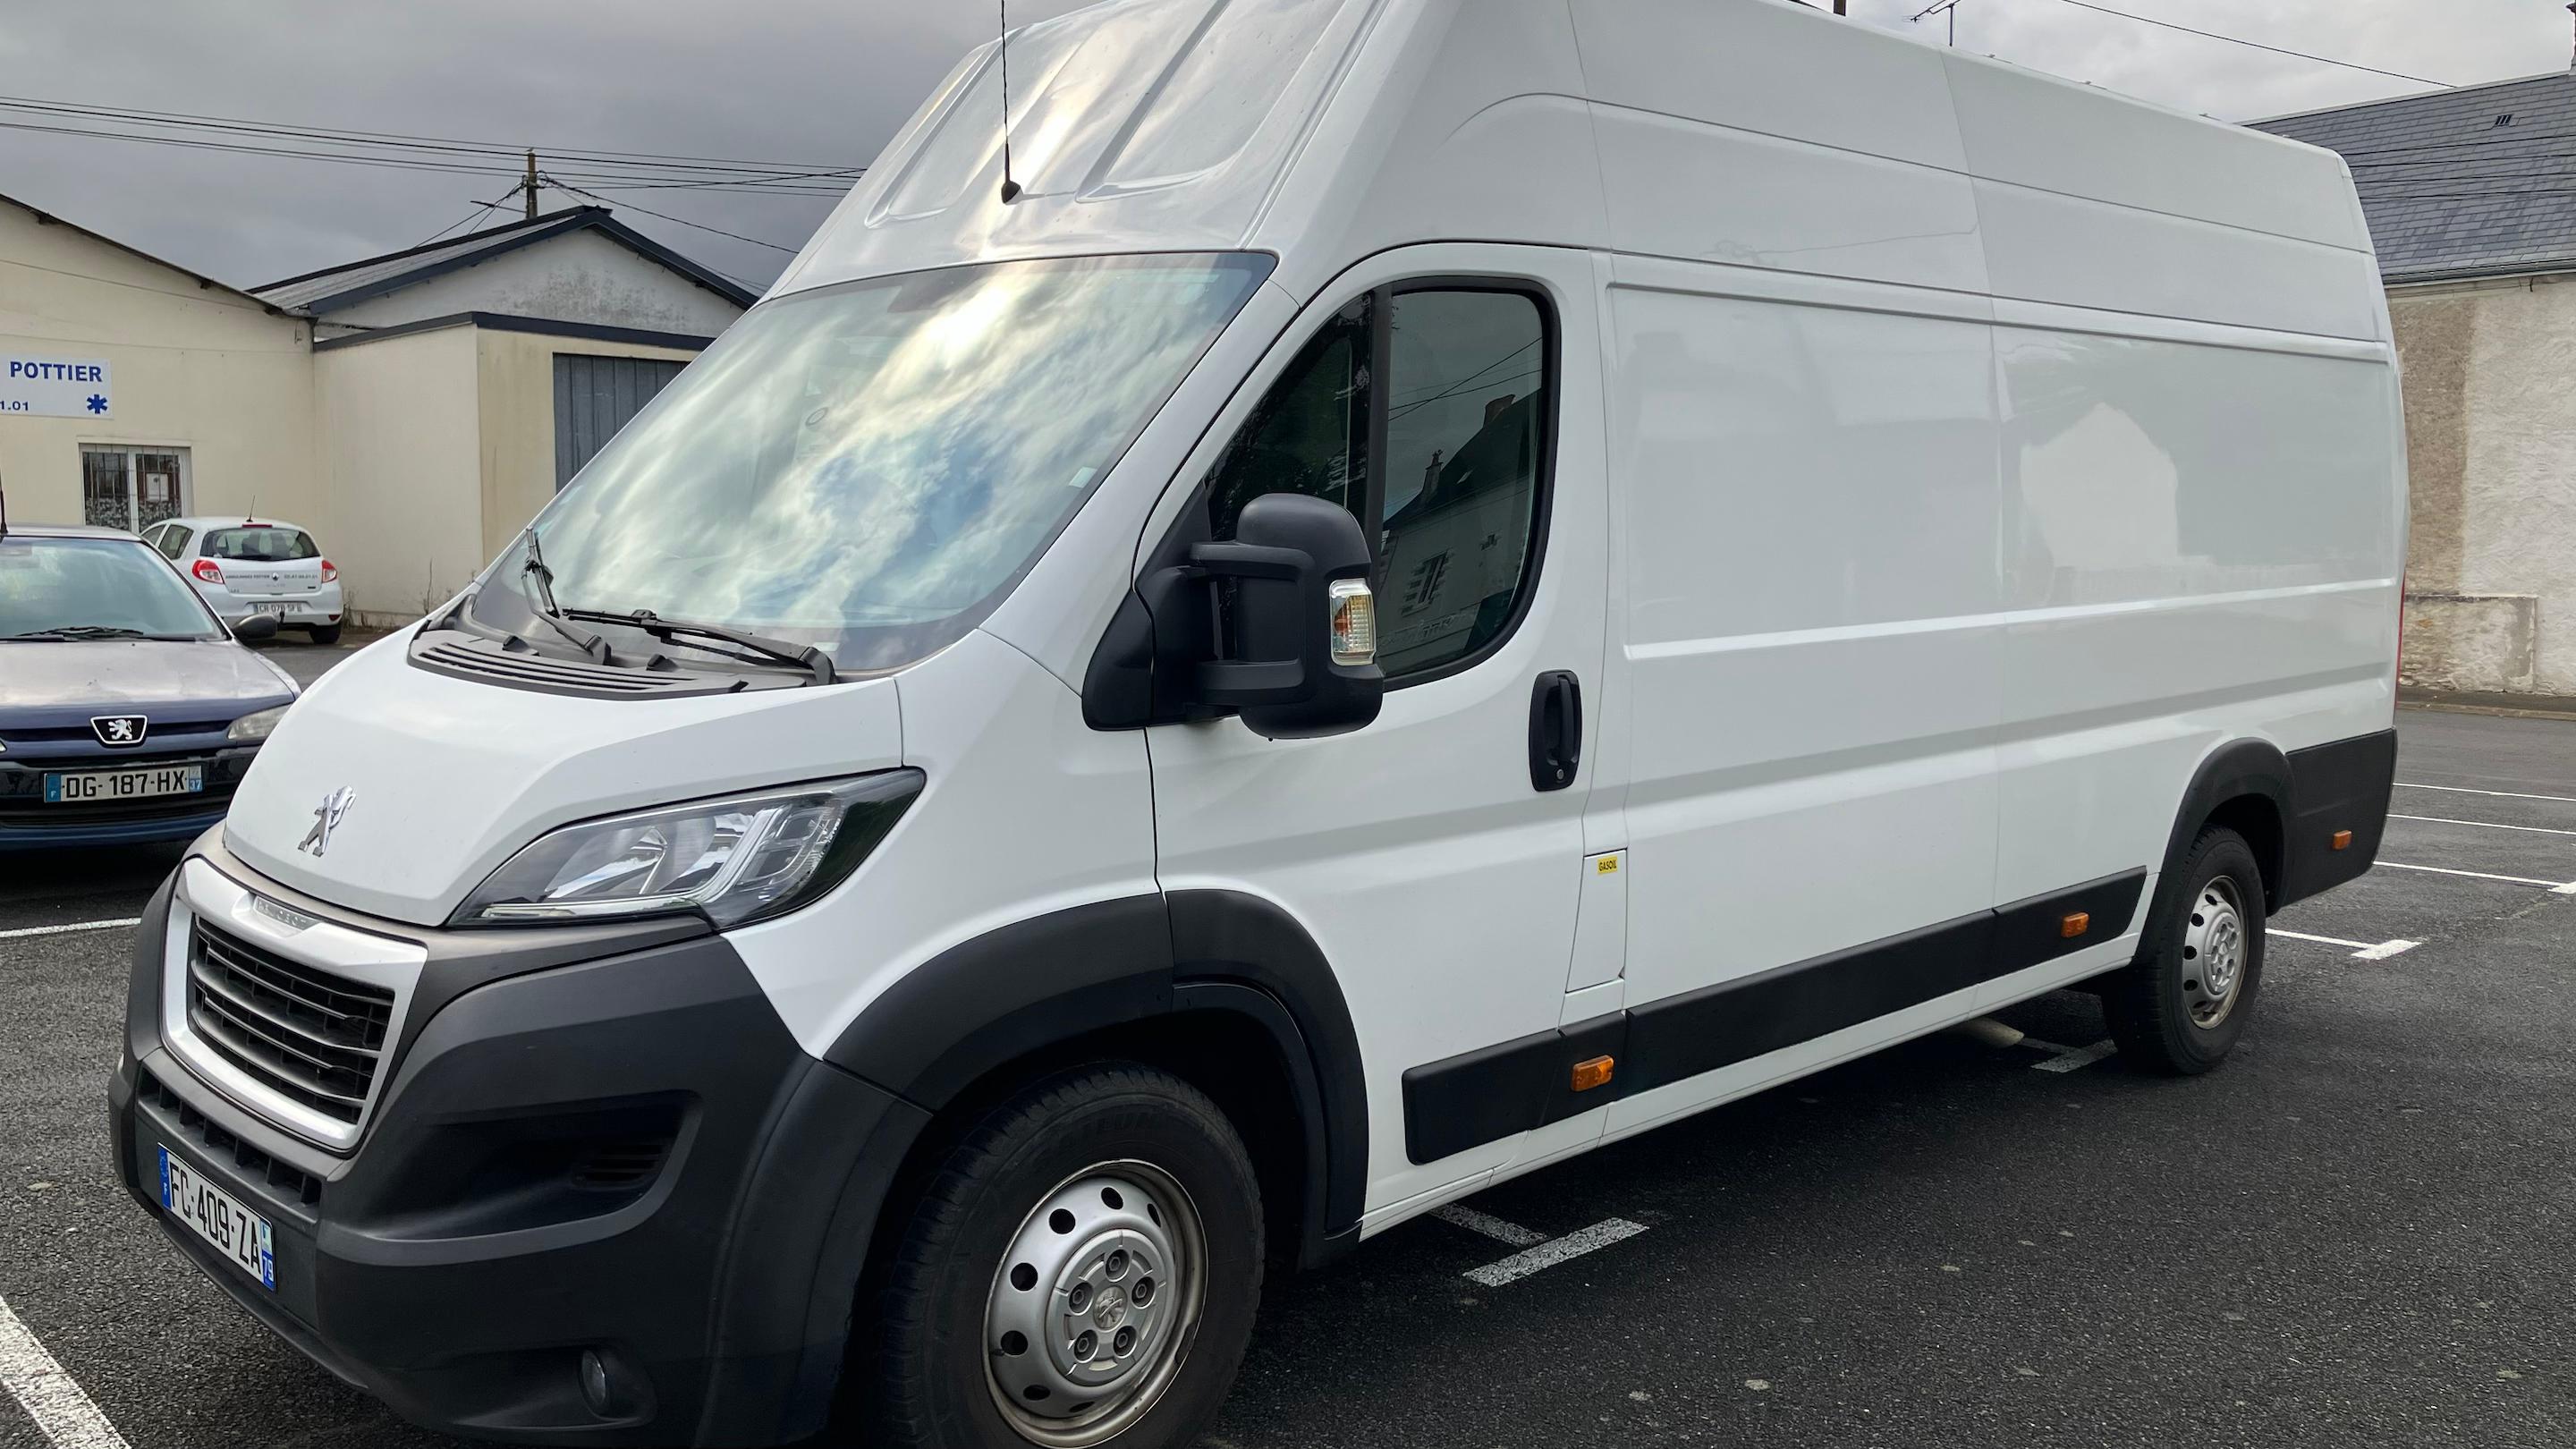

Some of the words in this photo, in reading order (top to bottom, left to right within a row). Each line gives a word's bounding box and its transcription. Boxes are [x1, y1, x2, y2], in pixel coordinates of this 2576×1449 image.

[10, 360, 102, 382] POTTIER
[65, 770, 185, 798] DG-187-HX
[190, 779, 201, 791] 37
[169, 1160, 262, 1275] FC-409-ZA
[263, 1255, 275, 1283] 79
